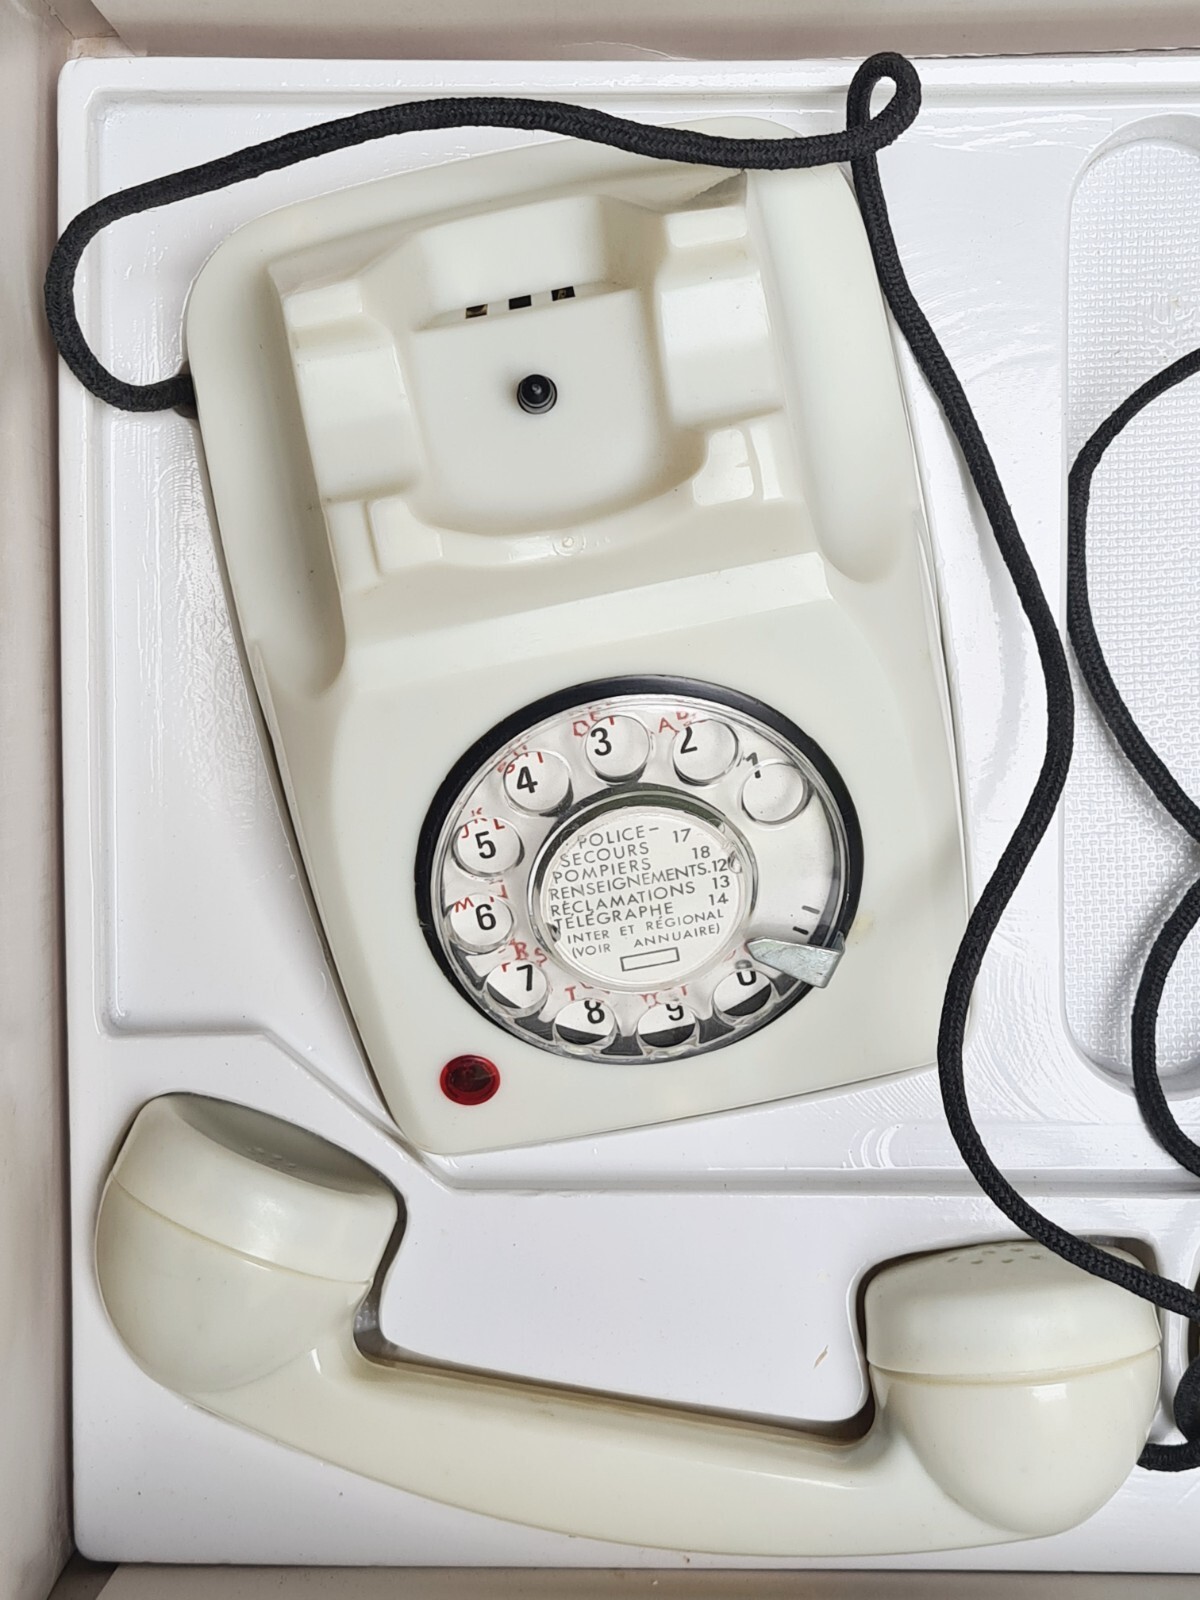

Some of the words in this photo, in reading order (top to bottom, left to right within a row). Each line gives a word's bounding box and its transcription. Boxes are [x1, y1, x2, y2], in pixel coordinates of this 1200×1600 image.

[590, 727, 612, 756] 3
[680, 726, 698, 754] 2
[745, 752, 761, 779] 1
[516, 766, 538, 794] 4
[475, 831, 497, 859] 5
[672, 828, 691, 843] 17
[552, 857, 652, 884] POMPIERS
[691, 845, 711, 860] 18
[560, 841, 649, 868] SECOURS
[711, 858, 728, 873] 12
[550, 881, 695, 918] RÉCLAMATIONS
[712, 875, 730, 890] 13
[475, 903, 497, 931] 6
[553, 901, 674, 931] TÉLÉGRAPHE
[708, 892, 729, 906] 14
[567, 929, 610, 944] INTER
[619, 924, 635, 937] ET
[645, 908, 724, 931] RÉGIONAL
[572, 943, 611, 959] (VOIR
[634, 922, 720, 948] ANNUAIRE)
[516, 963, 533, 992] 7
[584, 1000, 605, 1024] 8
